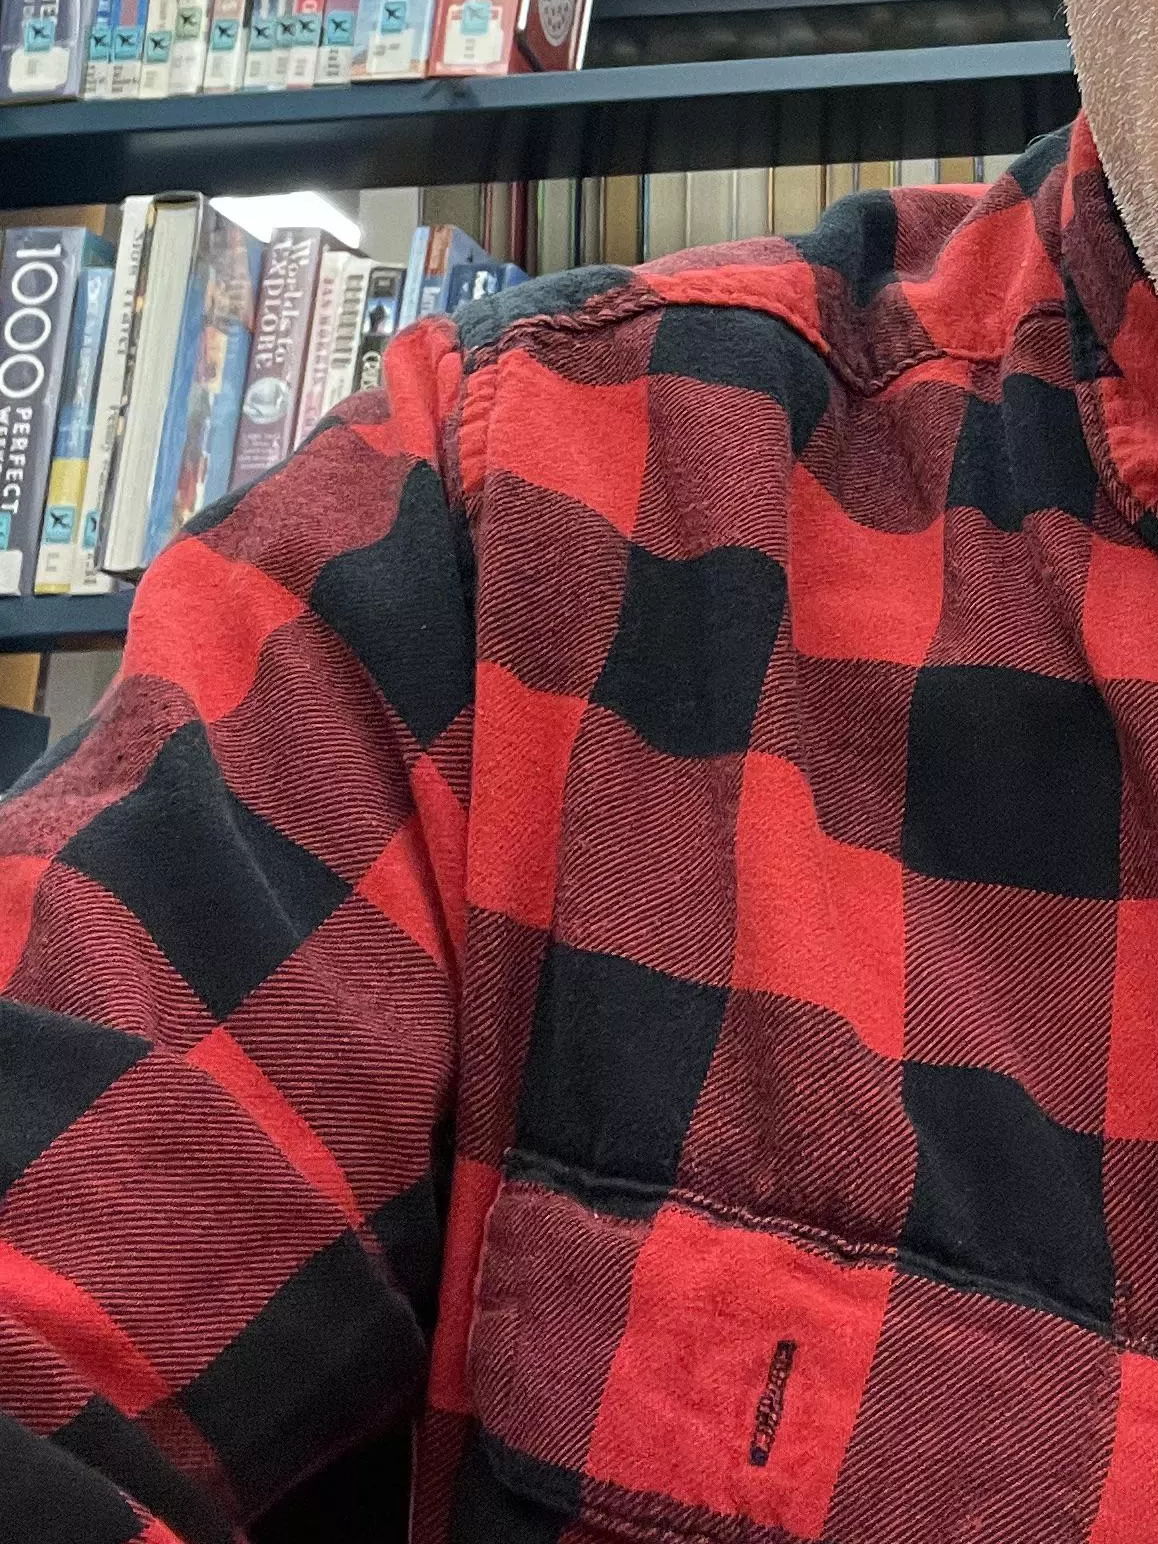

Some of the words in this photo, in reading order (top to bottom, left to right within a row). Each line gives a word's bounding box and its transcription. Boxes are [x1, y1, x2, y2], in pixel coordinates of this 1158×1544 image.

[0, 243, 62, 398] 1000
[256, 235, 293, 370] EXPLORE
[280, 238, 316, 332] Worlds
[275, 338, 294, 364] to
[2, 407, 33, 514] PERFECT
